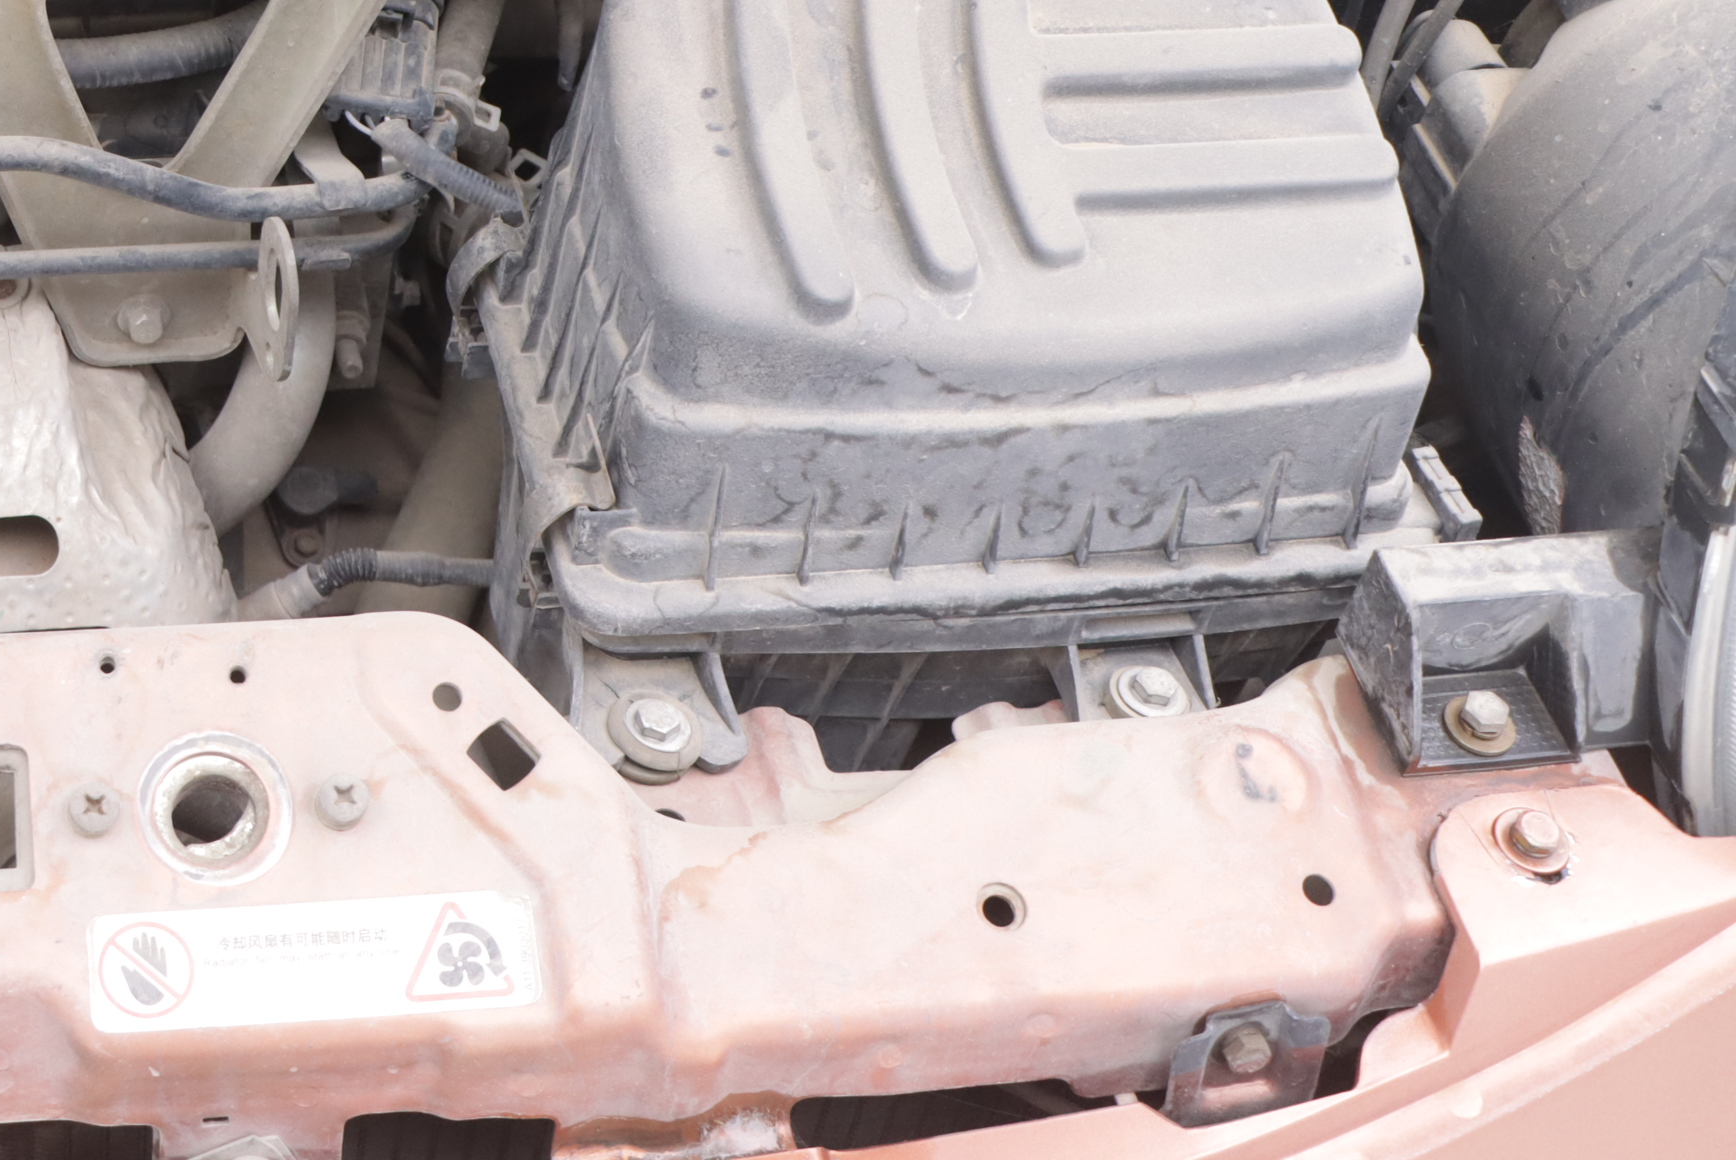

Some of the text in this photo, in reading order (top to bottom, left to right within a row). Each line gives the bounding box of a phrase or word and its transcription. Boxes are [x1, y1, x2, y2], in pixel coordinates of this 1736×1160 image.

[217, 927, 388, 951] 冷却风扇有可能随时启动
